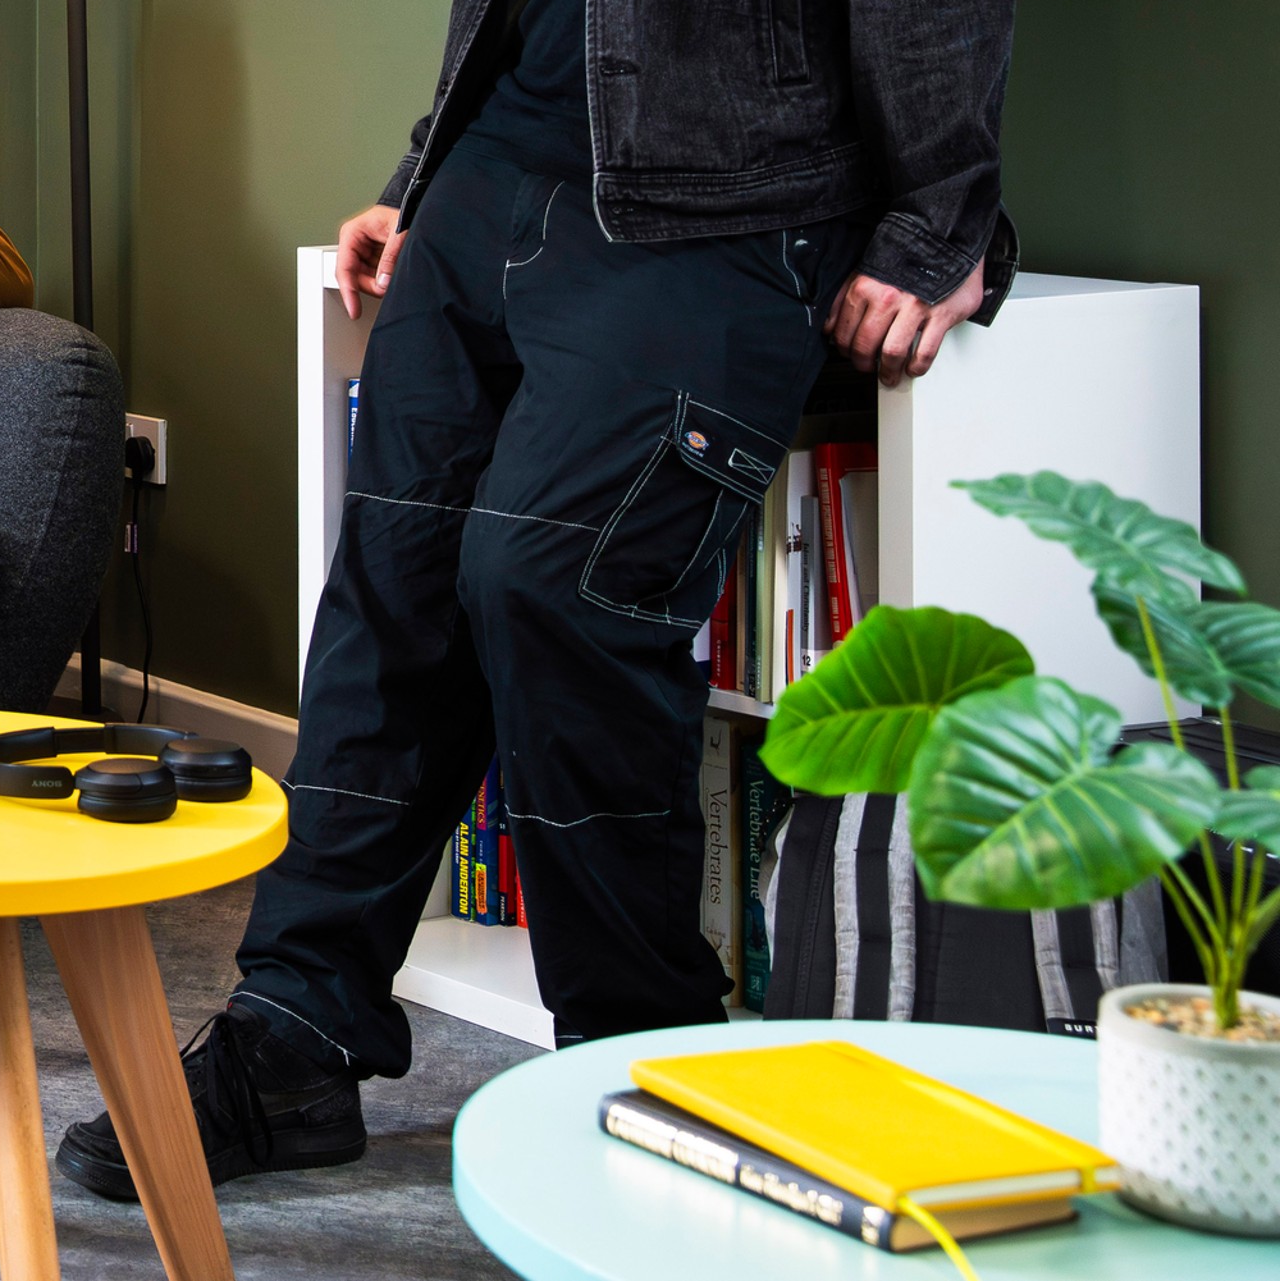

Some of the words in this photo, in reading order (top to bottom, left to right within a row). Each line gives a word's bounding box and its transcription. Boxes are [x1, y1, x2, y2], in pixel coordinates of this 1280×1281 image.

[802, 543, 810, 565] Islam
[802, 567, 810, 583] and
[801, 585, 811, 633] Christianity
[801, 655, 812, 667] 12
[31, 780, 63, 788] SONY
[478, 784, 486, 824] ENETICS
[459, 821, 470, 857] ALAIN
[709, 789, 728, 905] Vertebrates
[458, 857, 469, 915] ANDERTON
